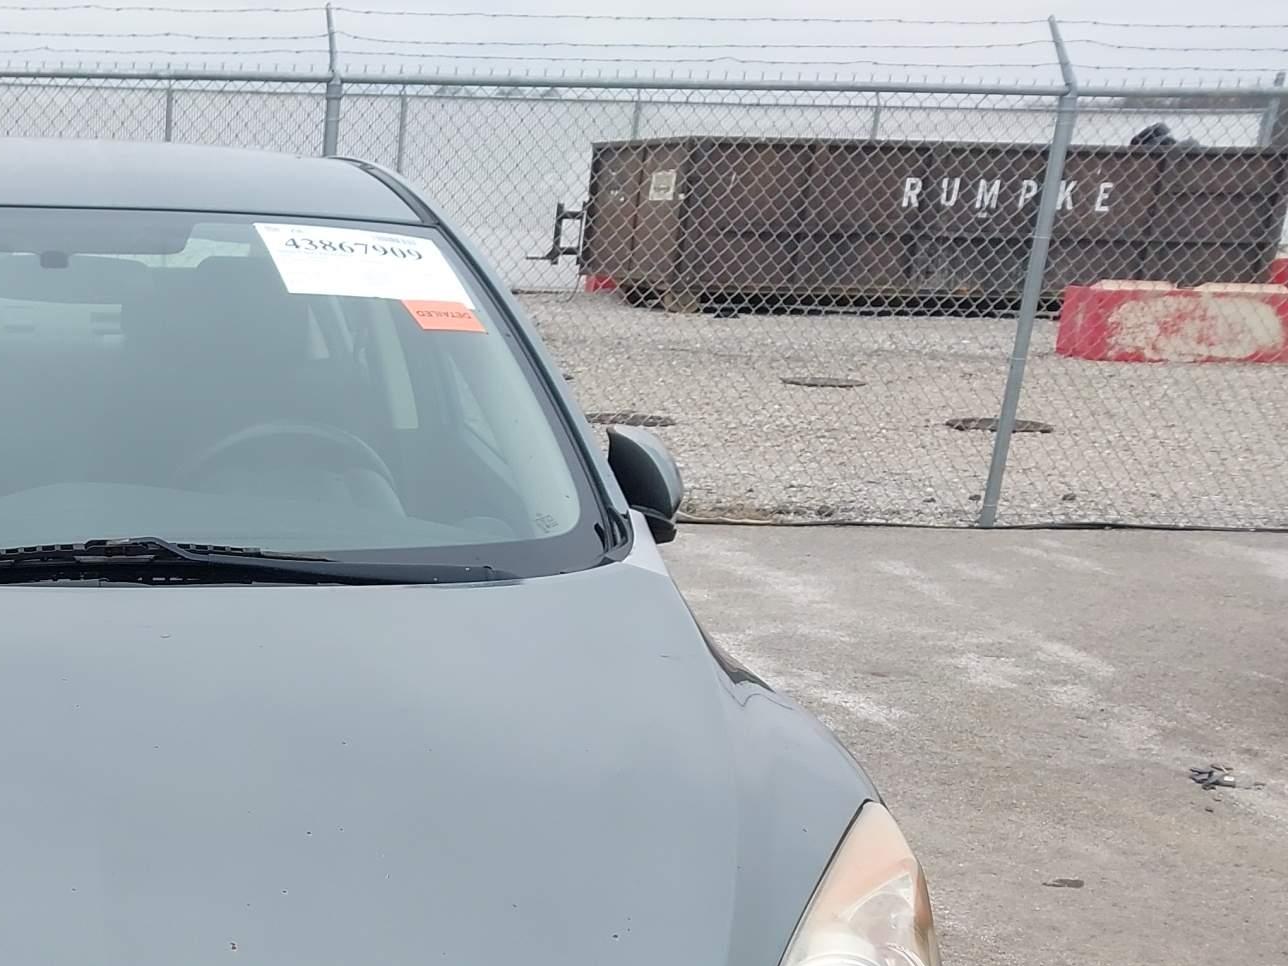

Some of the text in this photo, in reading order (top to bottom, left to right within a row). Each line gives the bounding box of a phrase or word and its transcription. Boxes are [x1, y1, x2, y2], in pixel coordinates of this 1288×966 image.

[902, 177, 1113, 212] RUMPKE
[285, 238, 423, 260] 43867909
[415, 310, 472, 319] DETAILED
